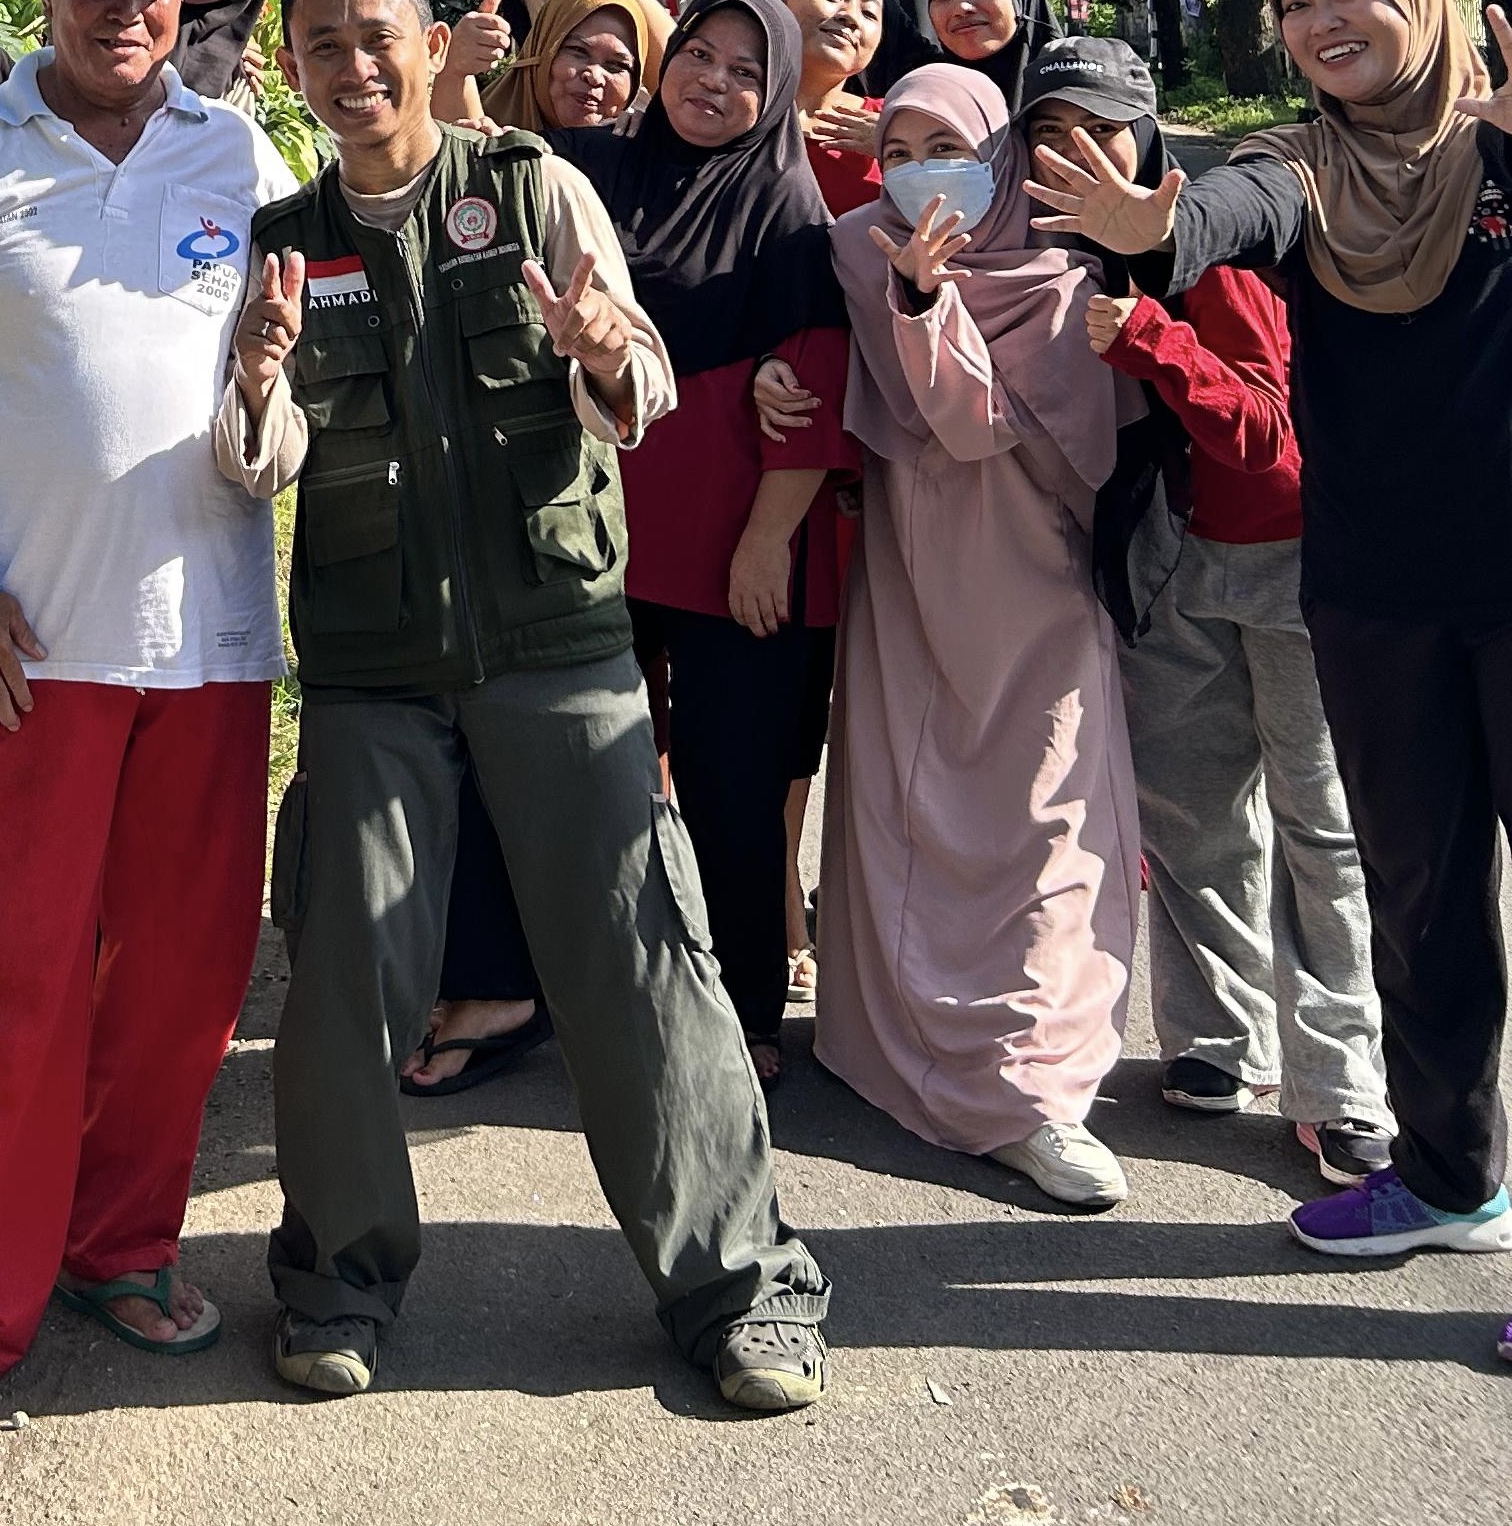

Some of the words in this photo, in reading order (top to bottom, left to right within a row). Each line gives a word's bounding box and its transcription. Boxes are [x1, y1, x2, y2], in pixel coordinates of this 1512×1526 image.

[192, 258, 238, 281] PAPUA
[190, 270, 236, 293] SEHAT
[196, 283, 230, 302] 2005
[308, 289, 379, 310] AHMADI
